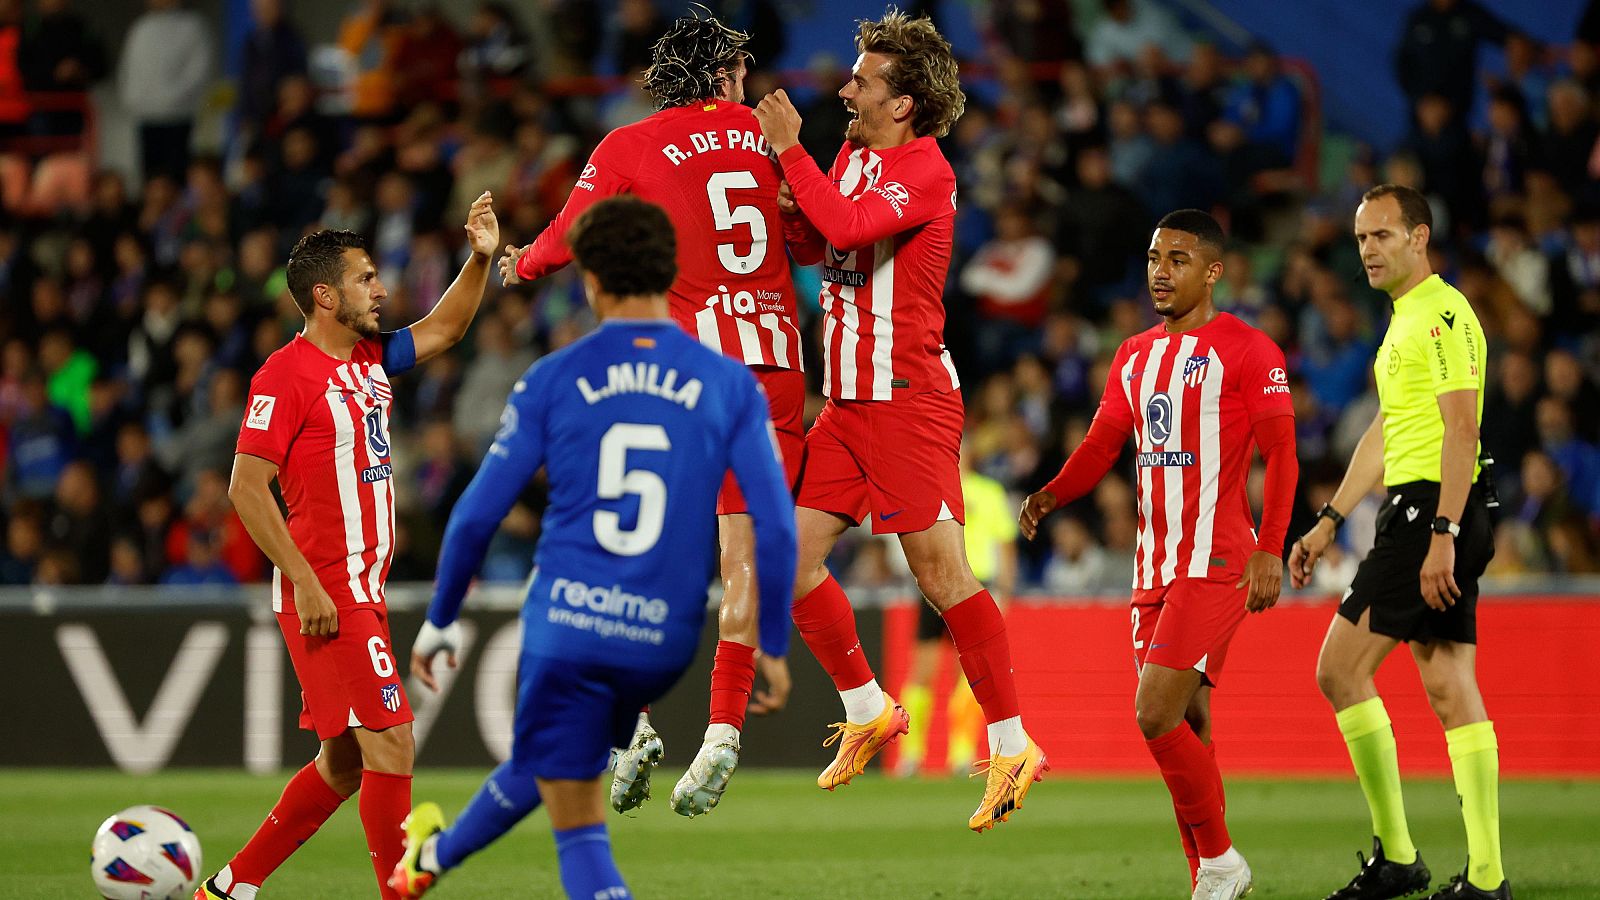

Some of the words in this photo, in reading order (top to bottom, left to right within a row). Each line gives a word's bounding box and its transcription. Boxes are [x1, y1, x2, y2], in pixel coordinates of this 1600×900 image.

[662, 144, 693, 166] R.
[689, 131, 722, 154] DE
[870, 186, 904, 219] HYUNDAI
[706, 170, 768, 275] 5
[756, 289, 782, 303] Money
[844, 271, 864, 286] AIR
[705, 284, 756, 316] ria
[1169, 452, 1193, 466] AIR
[592, 422, 672, 557] 5
[549, 577, 669, 625] realme
[547, 605, 665, 646] smartphone
[367, 635, 394, 678] 6
